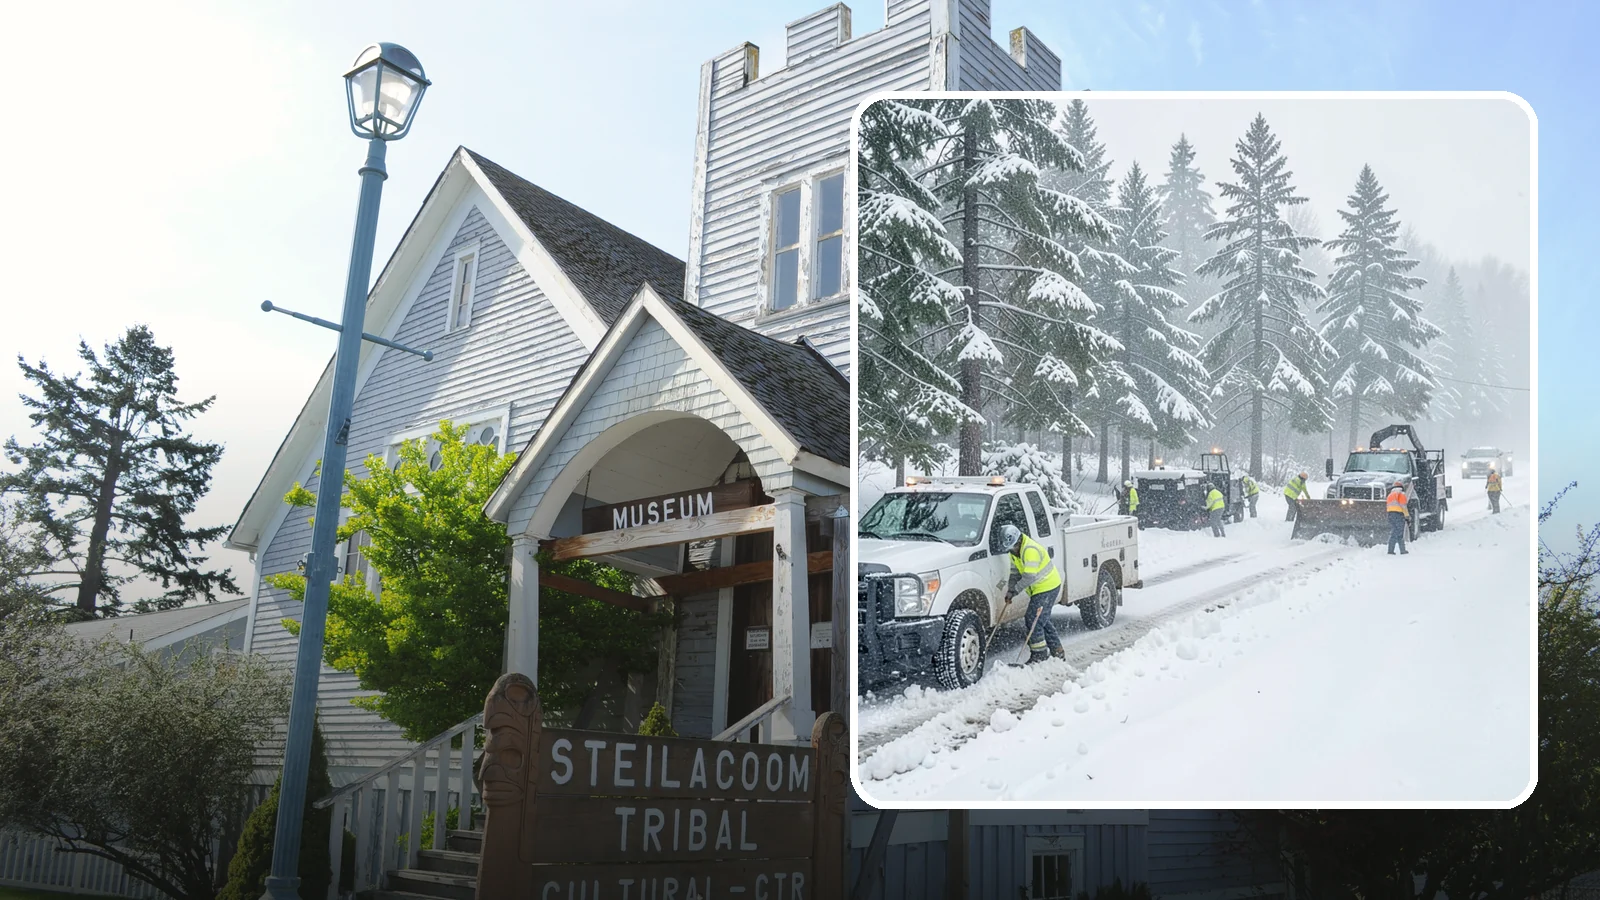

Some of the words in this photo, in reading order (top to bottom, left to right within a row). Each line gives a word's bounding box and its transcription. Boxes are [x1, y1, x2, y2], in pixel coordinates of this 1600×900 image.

[613, 491, 714, 531] MUSEUM
[550, 738, 810, 793] STEILACOOM
[614, 806, 758, 852] TRIBAL
